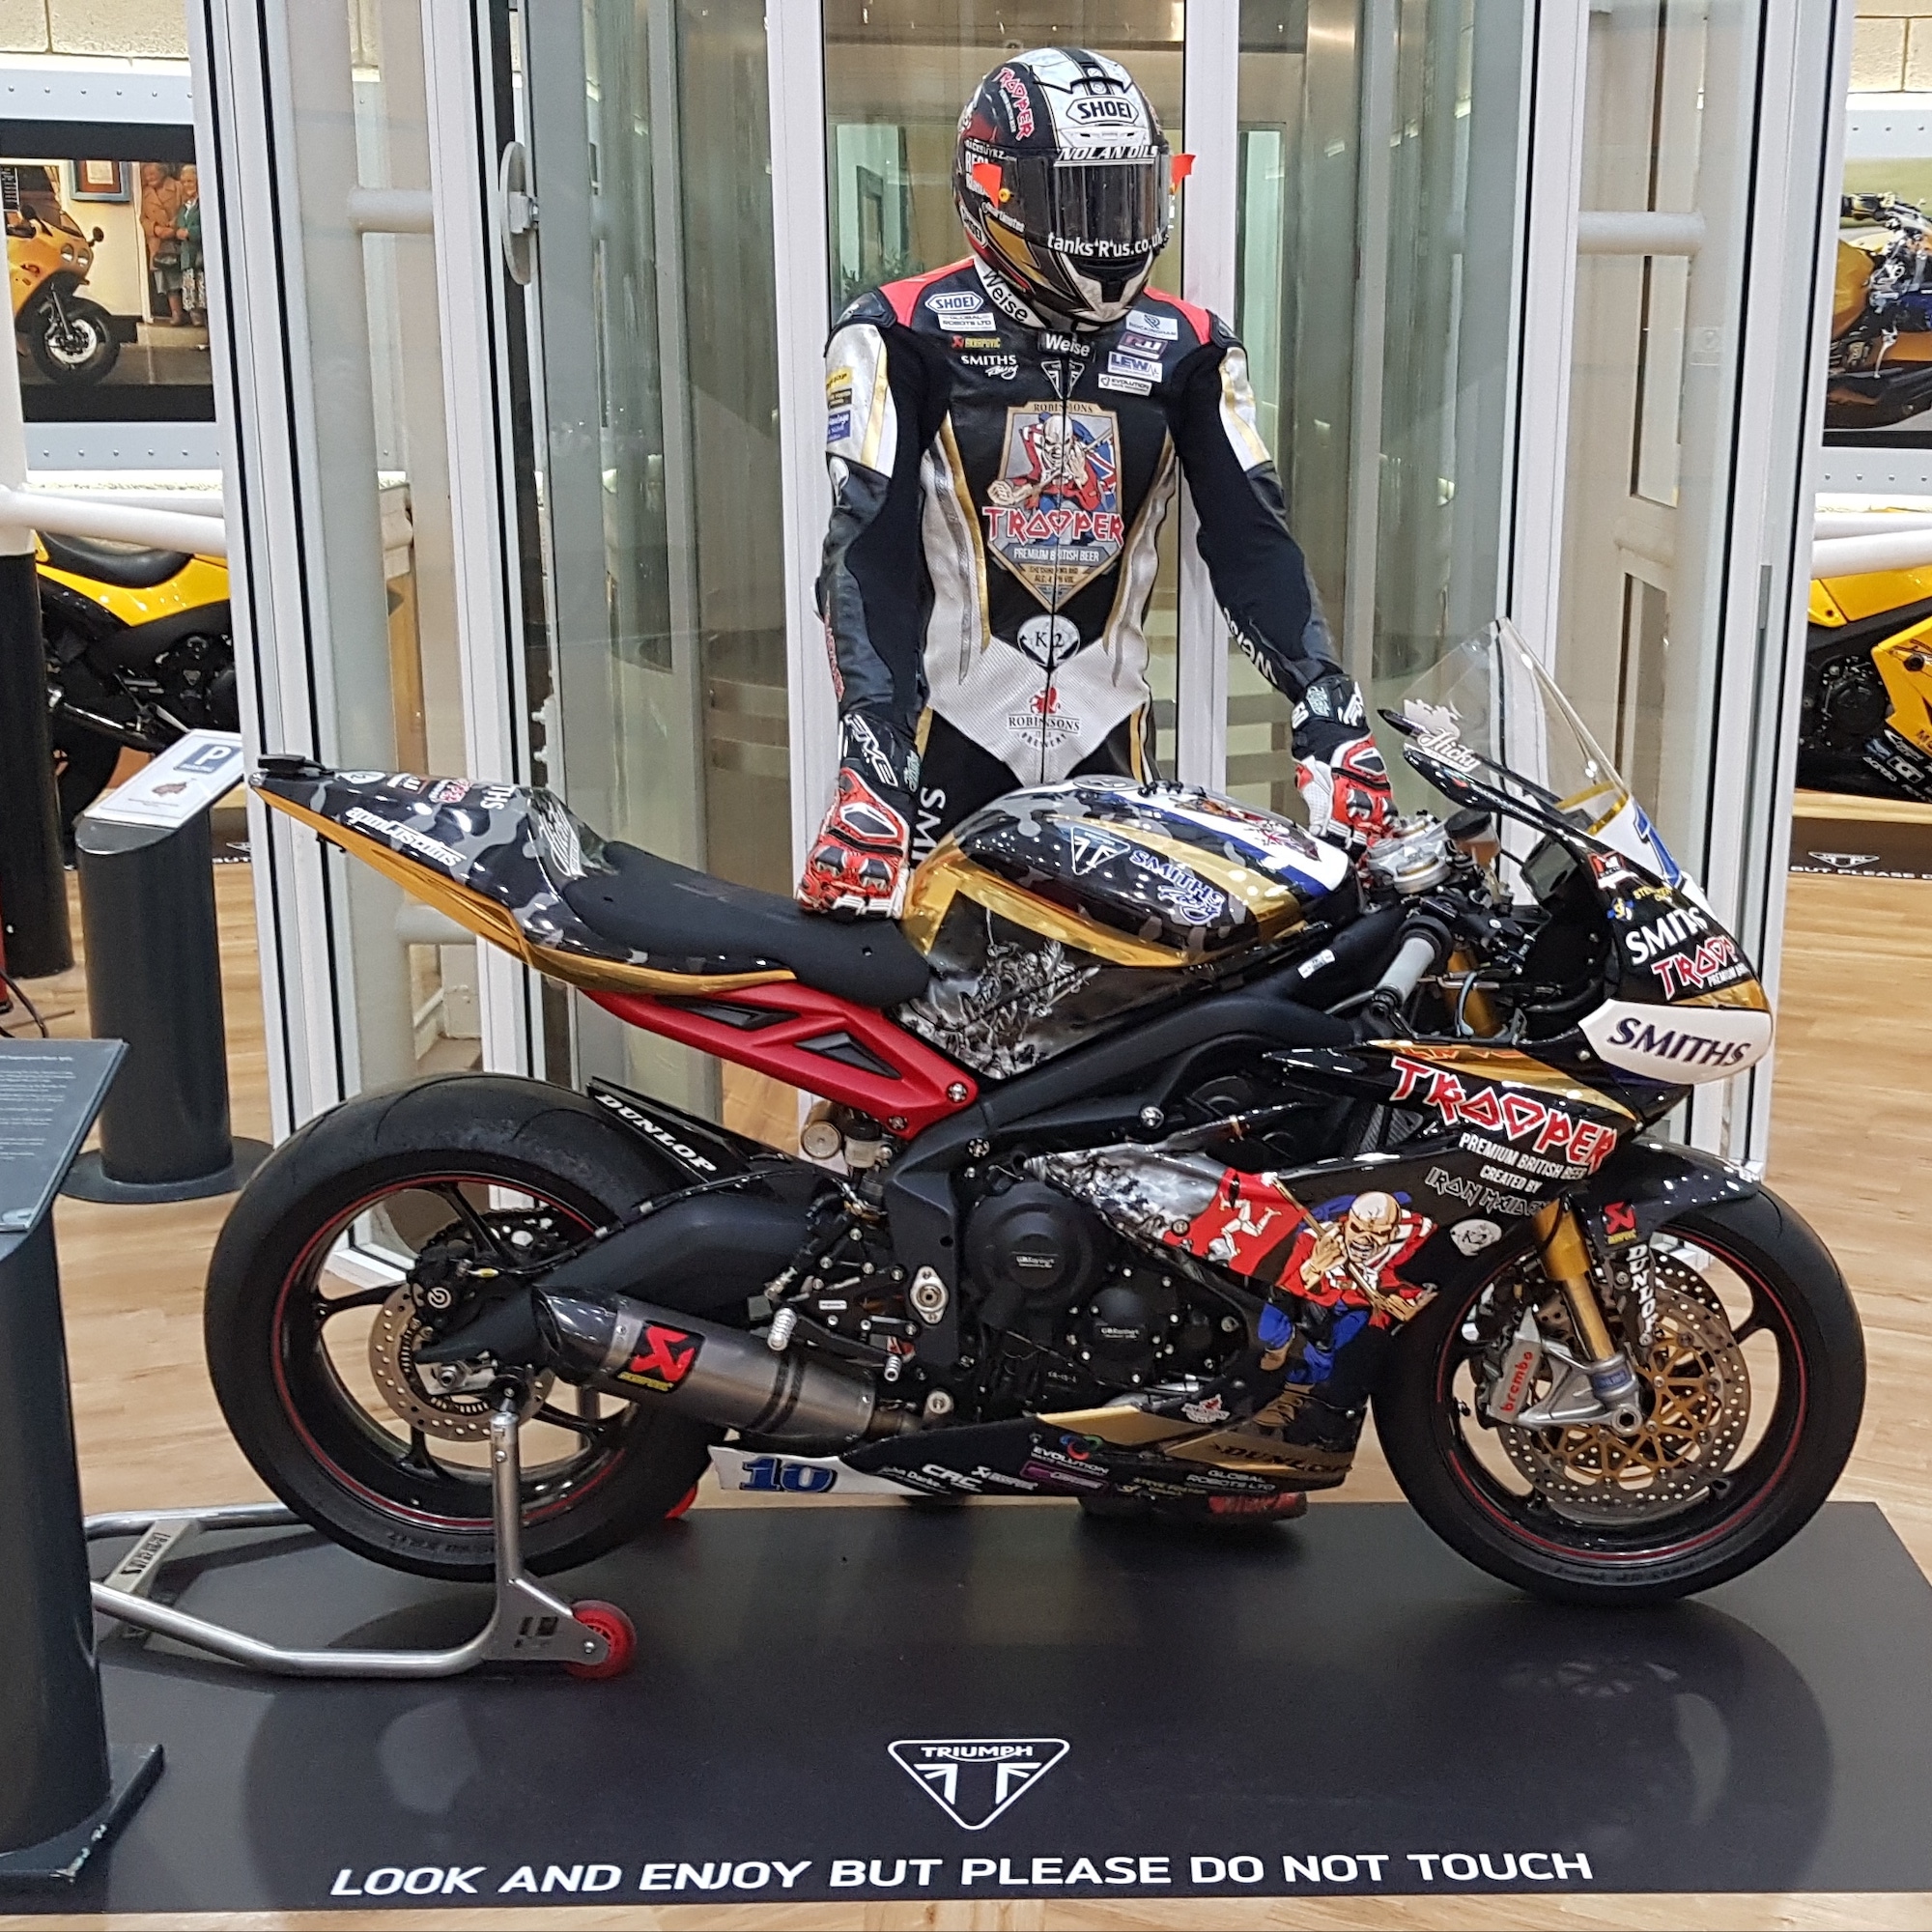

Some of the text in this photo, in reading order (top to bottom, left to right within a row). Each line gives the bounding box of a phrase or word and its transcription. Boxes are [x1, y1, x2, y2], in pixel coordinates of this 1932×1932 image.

[1077, 99, 1132, 121] SHOEI
[1058, 145, 1159, 161] NOLAN OILS
[935, 296, 976, 309] SHOEI
[982, 269, 1029, 324] Weise
[1045, 332, 1092, 357] Weise
[960, 355, 1017, 366] SMITHS
[1111, 354, 1150, 371] LEW
[981, 505, 1125, 549] TROOPER
[1013, 548, 1050, 559] PREMIUM
[1079, 550, 1100, 562] BEER
[1009, 716, 1080, 731] ROBINSONS
[1128, 850, 1227, 910] SMITHS
[1837, 867, 1916, 879] PLEASE
[1606, 1016, 1751, 1066] SMITHS
[1389, 1055, 1618, 1177] TROOPER
[594, 1094, 718, 1172] DUNLOP
[1459, 1132, 1589, 1180] PREMIUM BRITISH BEER
[1424, 1165, 1484, 1208] IRON
[1480, 1165, 1544, 1194] CREATED BY
[1626, 1243, 1660, 1334] DUNLOP
[1500, 1351, 1534, 1412] brembo
[739, 1456, 838, 1493] 10
[1033, 1445, 1110, 1475] EVOLUTION
[922, 1463, 983, 1490] CRC
[1186, 1474, 1247, 1490] ROBOTS
[1248, 1481, 1276, 1491] LTD
[1207, 1469, 1266, 1484] GLOBAL
[921, 1745, 1035, 1761] TRIUMPH
[329, 1852, 1594, 1896] LOOK AND ENJOY BUT PLEASE DO NOT TOUCH
